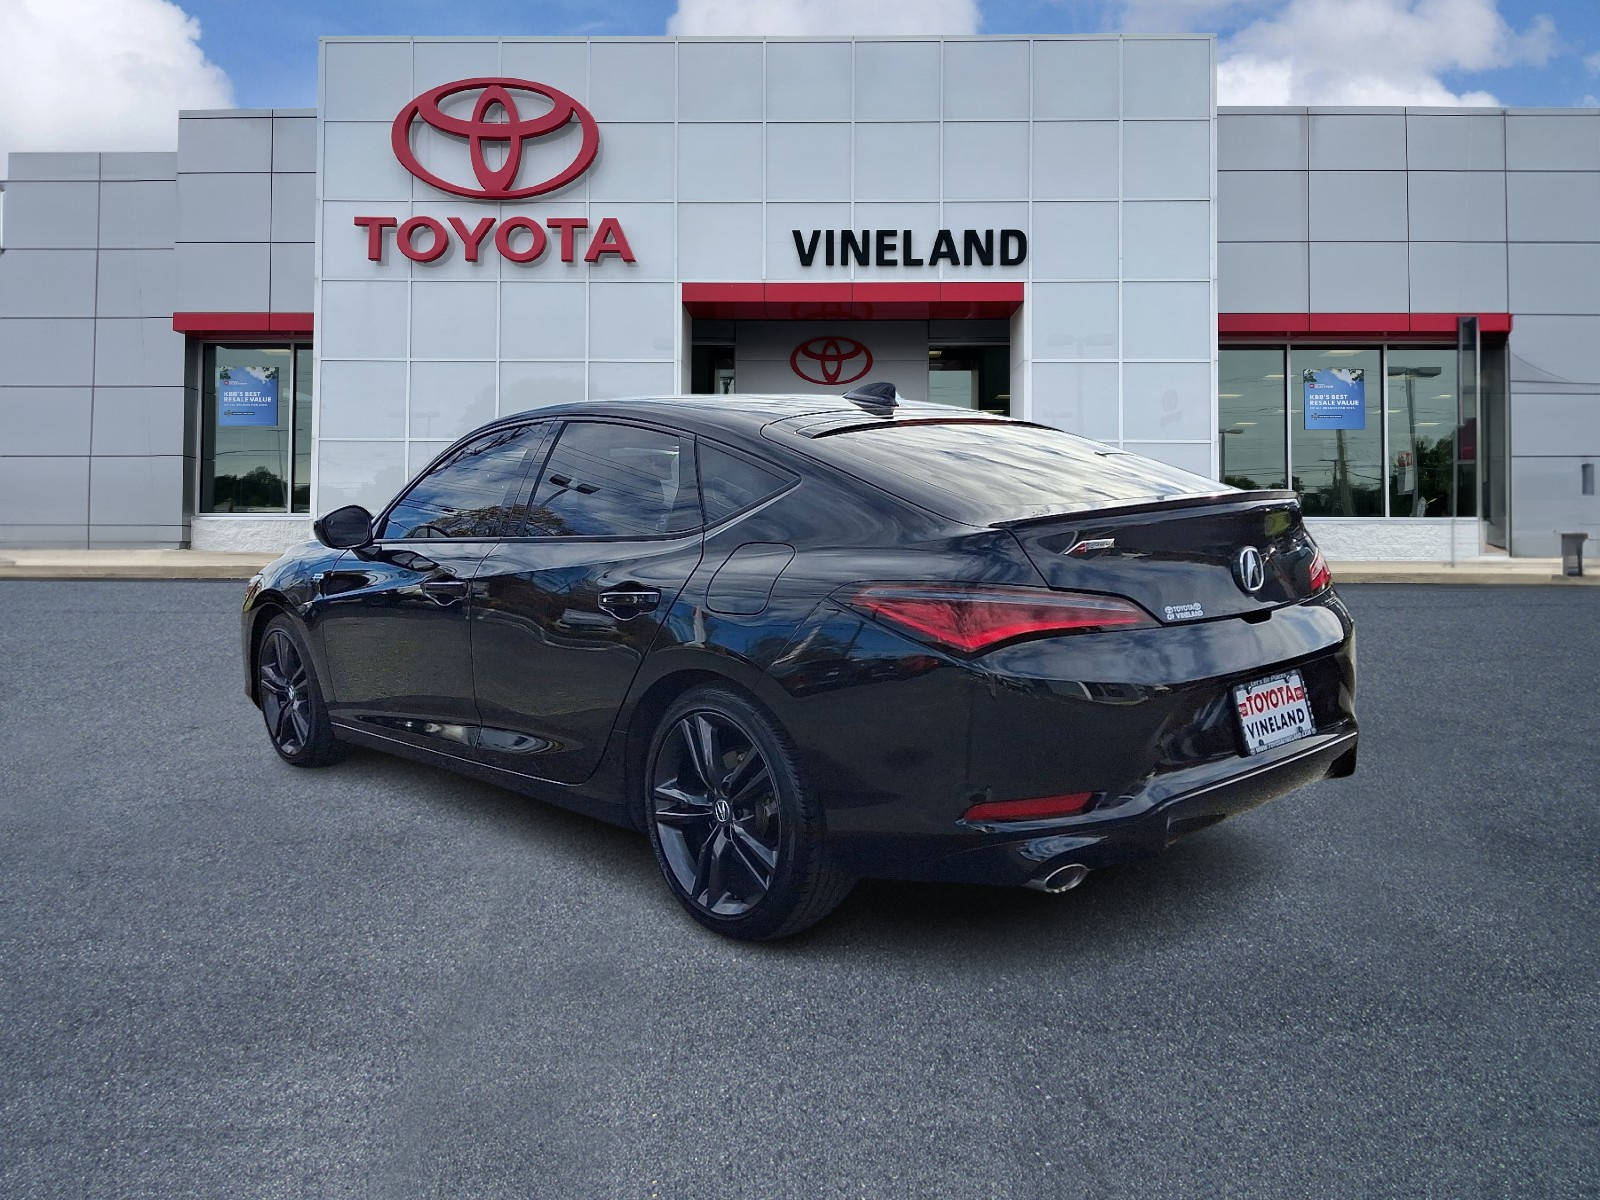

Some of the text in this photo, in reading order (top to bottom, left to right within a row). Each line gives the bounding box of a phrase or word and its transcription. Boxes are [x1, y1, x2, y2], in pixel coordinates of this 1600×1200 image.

[354, 216, 636, 263] TOYOTA
[792, 229, 1028, 266] VINELAND
[1173, 604, 1194, 612] TOYOTA
[1175, 610, 1204, 619] VINELAND
[1246, 685, 1296, 715] TOYOTA
[1246, 708, 1305, 739] VINELAND
